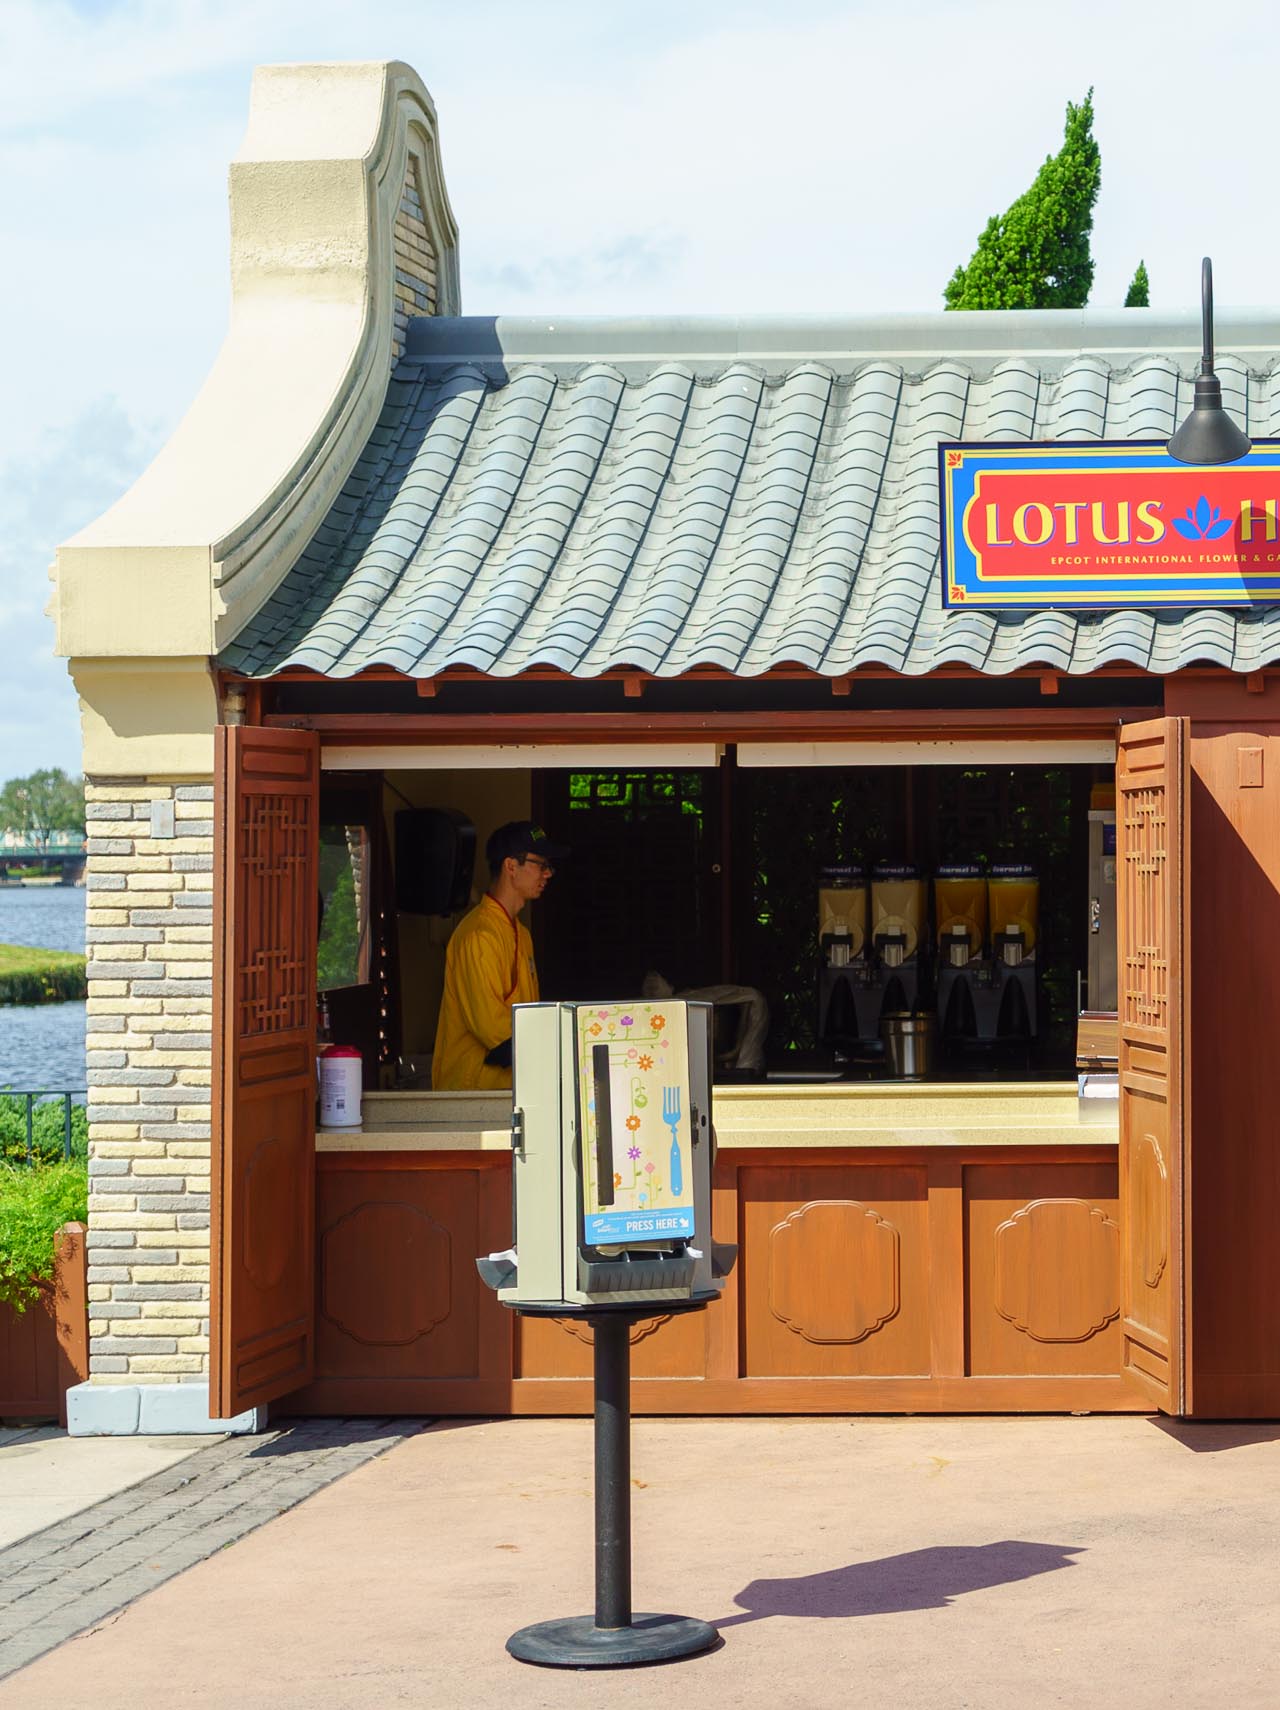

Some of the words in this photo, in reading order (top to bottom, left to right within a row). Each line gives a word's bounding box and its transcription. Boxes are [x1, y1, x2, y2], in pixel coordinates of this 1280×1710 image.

[985, 500, 1166, 547] LOTUS
[1051, 556, 1090, 565] EPCOT
[1096, 555, 1193, 564] INTERNATIONAL
[1200, 554, 1247, 563] FLOWER
[1253, 554, 1261, 562] &
[626, 1220, 654, 1232] PRESS
[655, 1218, 678, 1230] HERE
